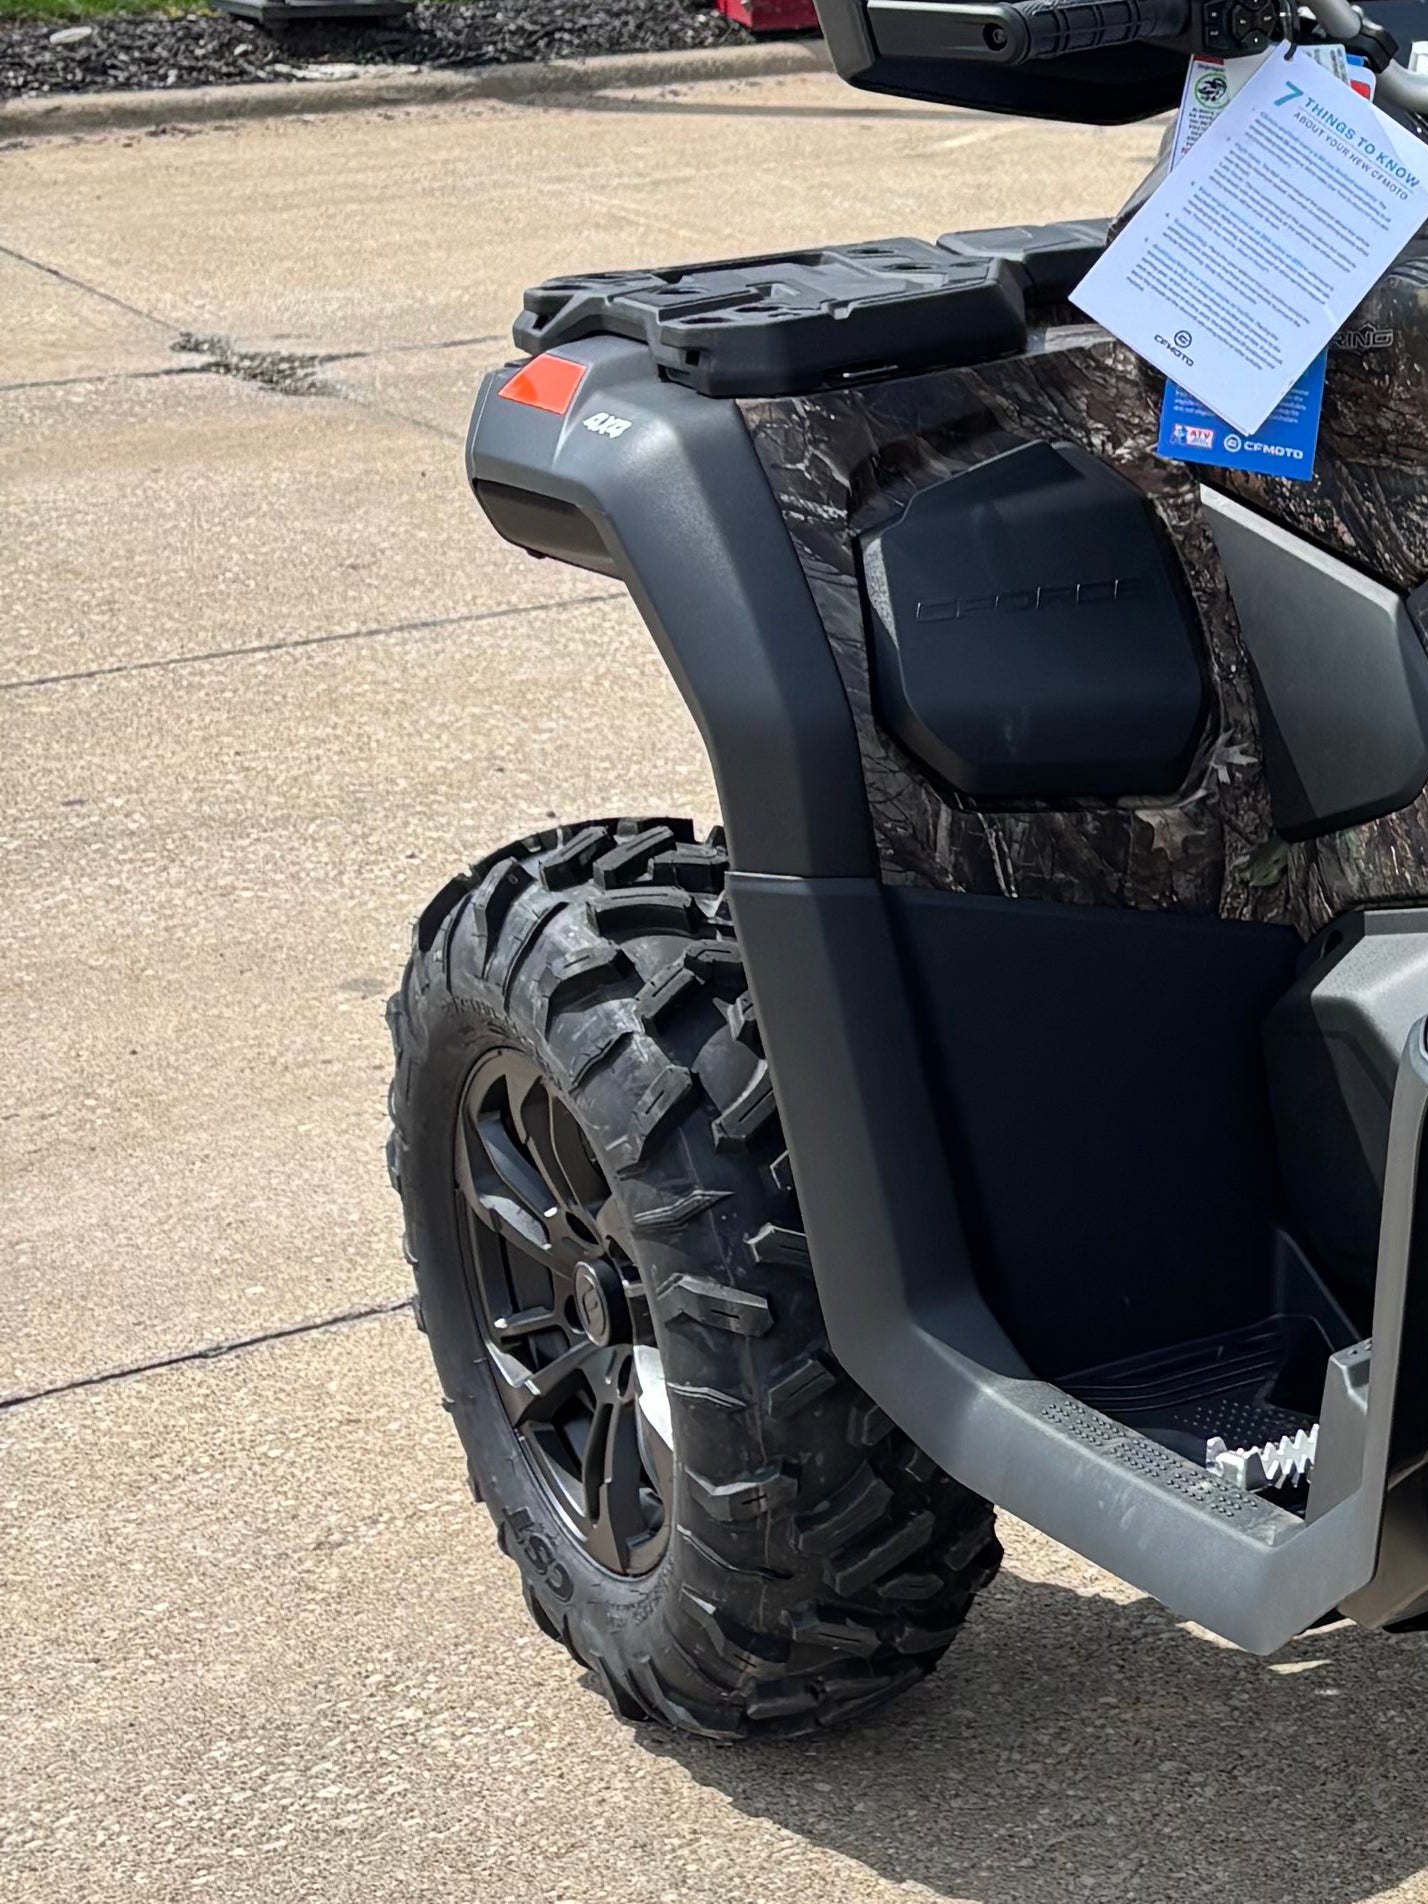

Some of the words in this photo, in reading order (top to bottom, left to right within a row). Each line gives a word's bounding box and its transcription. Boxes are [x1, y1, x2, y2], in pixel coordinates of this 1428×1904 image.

[1273, 80, 1305, 107] 7
[1292, 111, 1325, 138] ABOUT
[1325, 135, 1350, 158] YOUR
[1349, 154, 1371, 173] NEW
[1371, 169, 1409, 201] CFMOTO
[1304, 96, 1357, 141] THINGS
[1357, 137, 1376, 155] TO
[1376, 151, 1421, 189] KNOW
[1153, 333, 1195, 368] CFMOTO
[1243, 440, 1304, 460] CFMOTO
[501, 1505, 575, 1603] CST
